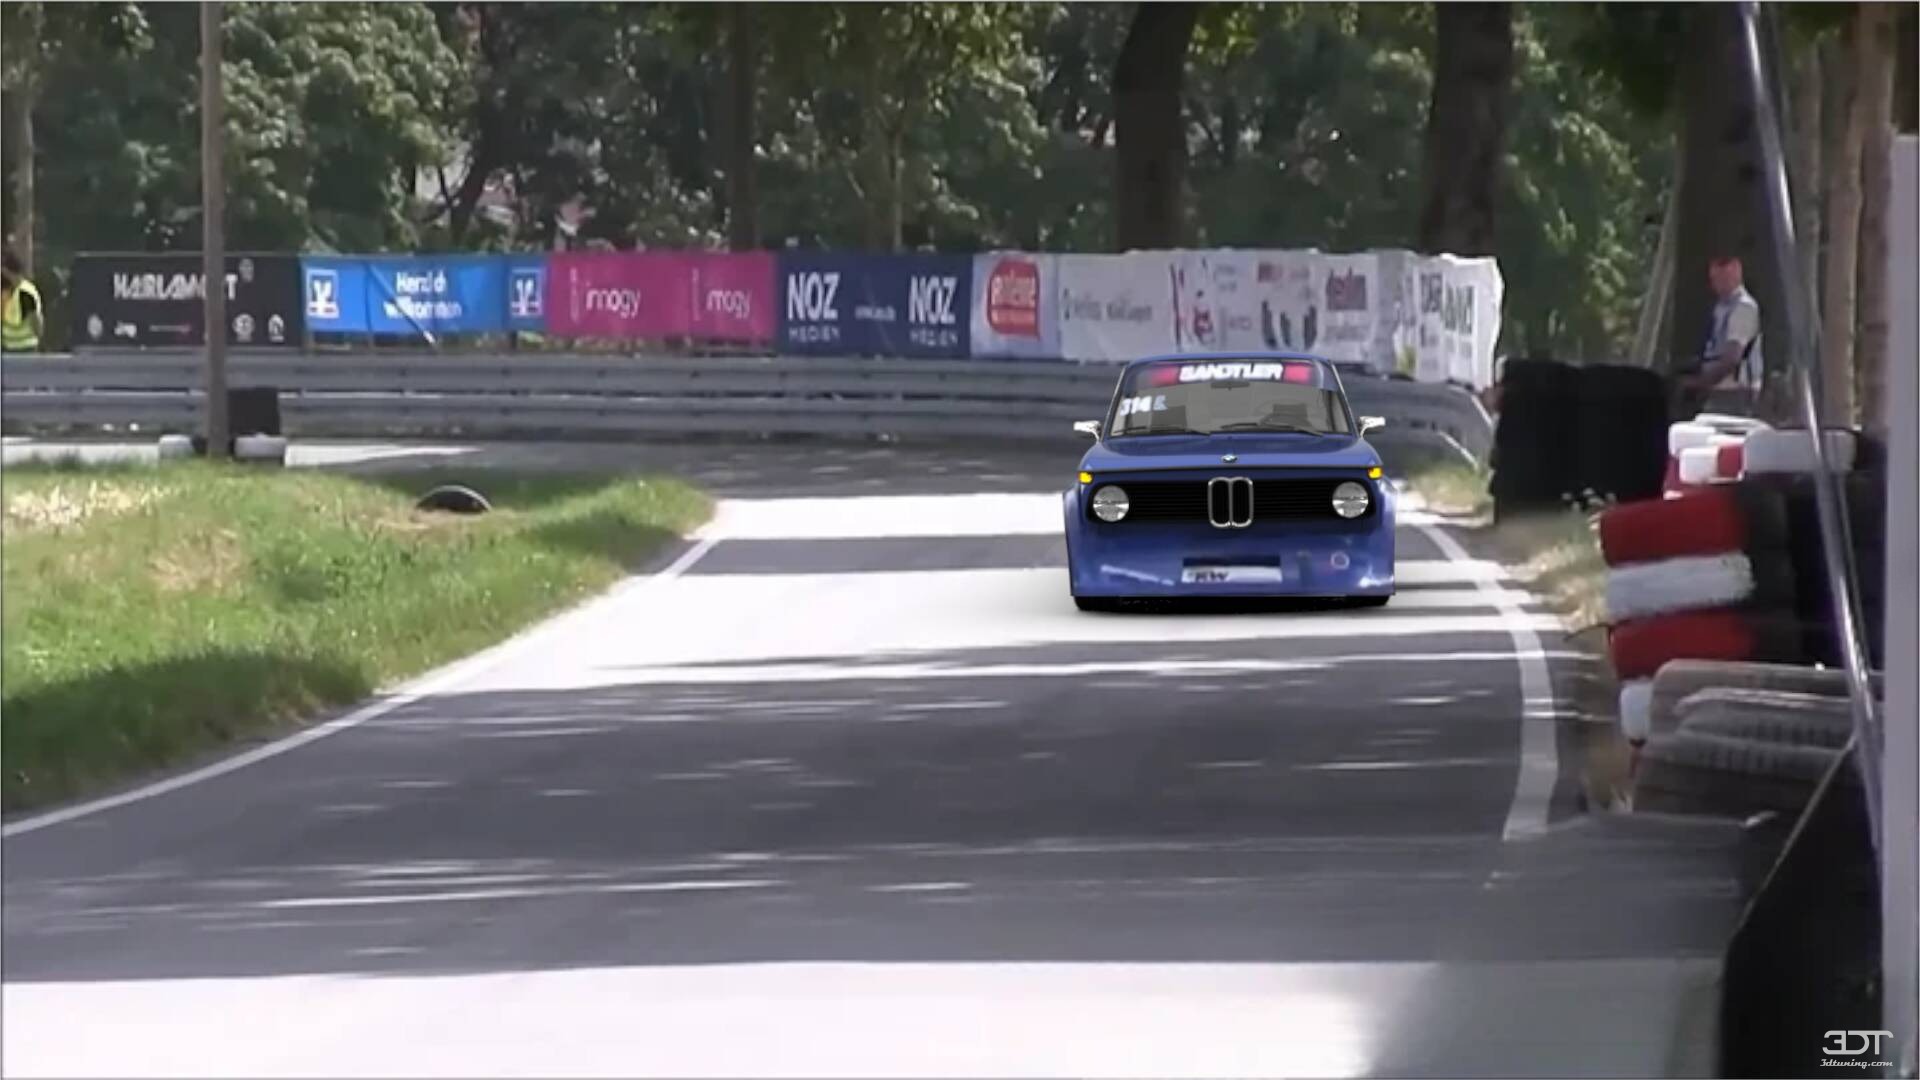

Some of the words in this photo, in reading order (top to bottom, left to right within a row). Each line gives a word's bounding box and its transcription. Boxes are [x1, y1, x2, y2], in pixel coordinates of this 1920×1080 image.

[787, 272, 840, 321] NOZ
[908, 275, 958, 325] NOZ
[1179, 363, 1284, 382] SANDTLER
